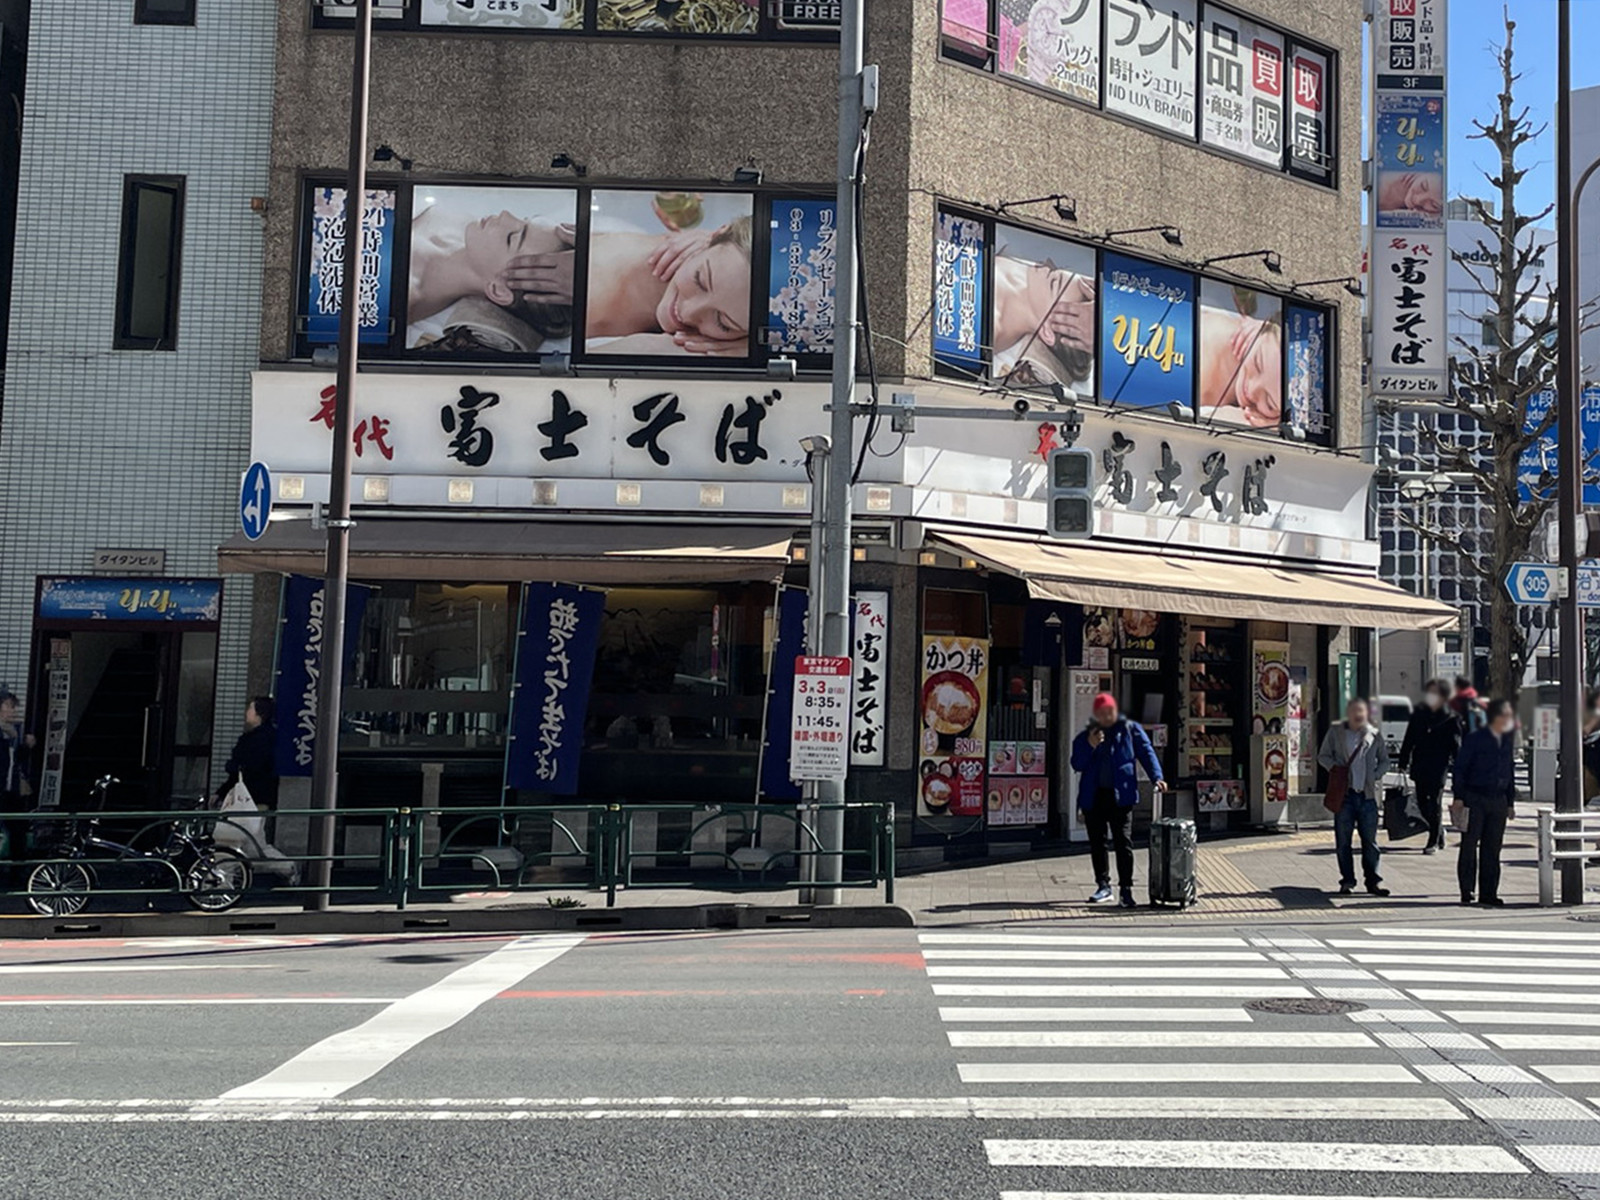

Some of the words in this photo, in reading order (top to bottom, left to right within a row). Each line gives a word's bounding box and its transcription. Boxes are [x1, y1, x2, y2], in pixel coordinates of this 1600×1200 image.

[794, 5, 841, 19] FREE
[1402, 77, 1420, 88] 3F
[1129, 90, 1151, 109] LUX
[1154, 98, 1193, 124] BRAND
[1388, 237, 1432, 256] 名代
[1391, 257, 1433, 365] 富士そば
[1380, 378, 1438, 391] ダイタンビル
[440, 385, 783, 467] 富士そば
[1102, 430, 1276, 517] 富士そば
[100, 554, 159, 566] ダイタンビル
[1525, 576, 1547, 592] 305
[857, 602, 885, 628] 名代
[926, 645, 984, 675] かつ丼
[852, 632, 884, 754] 富士そば
